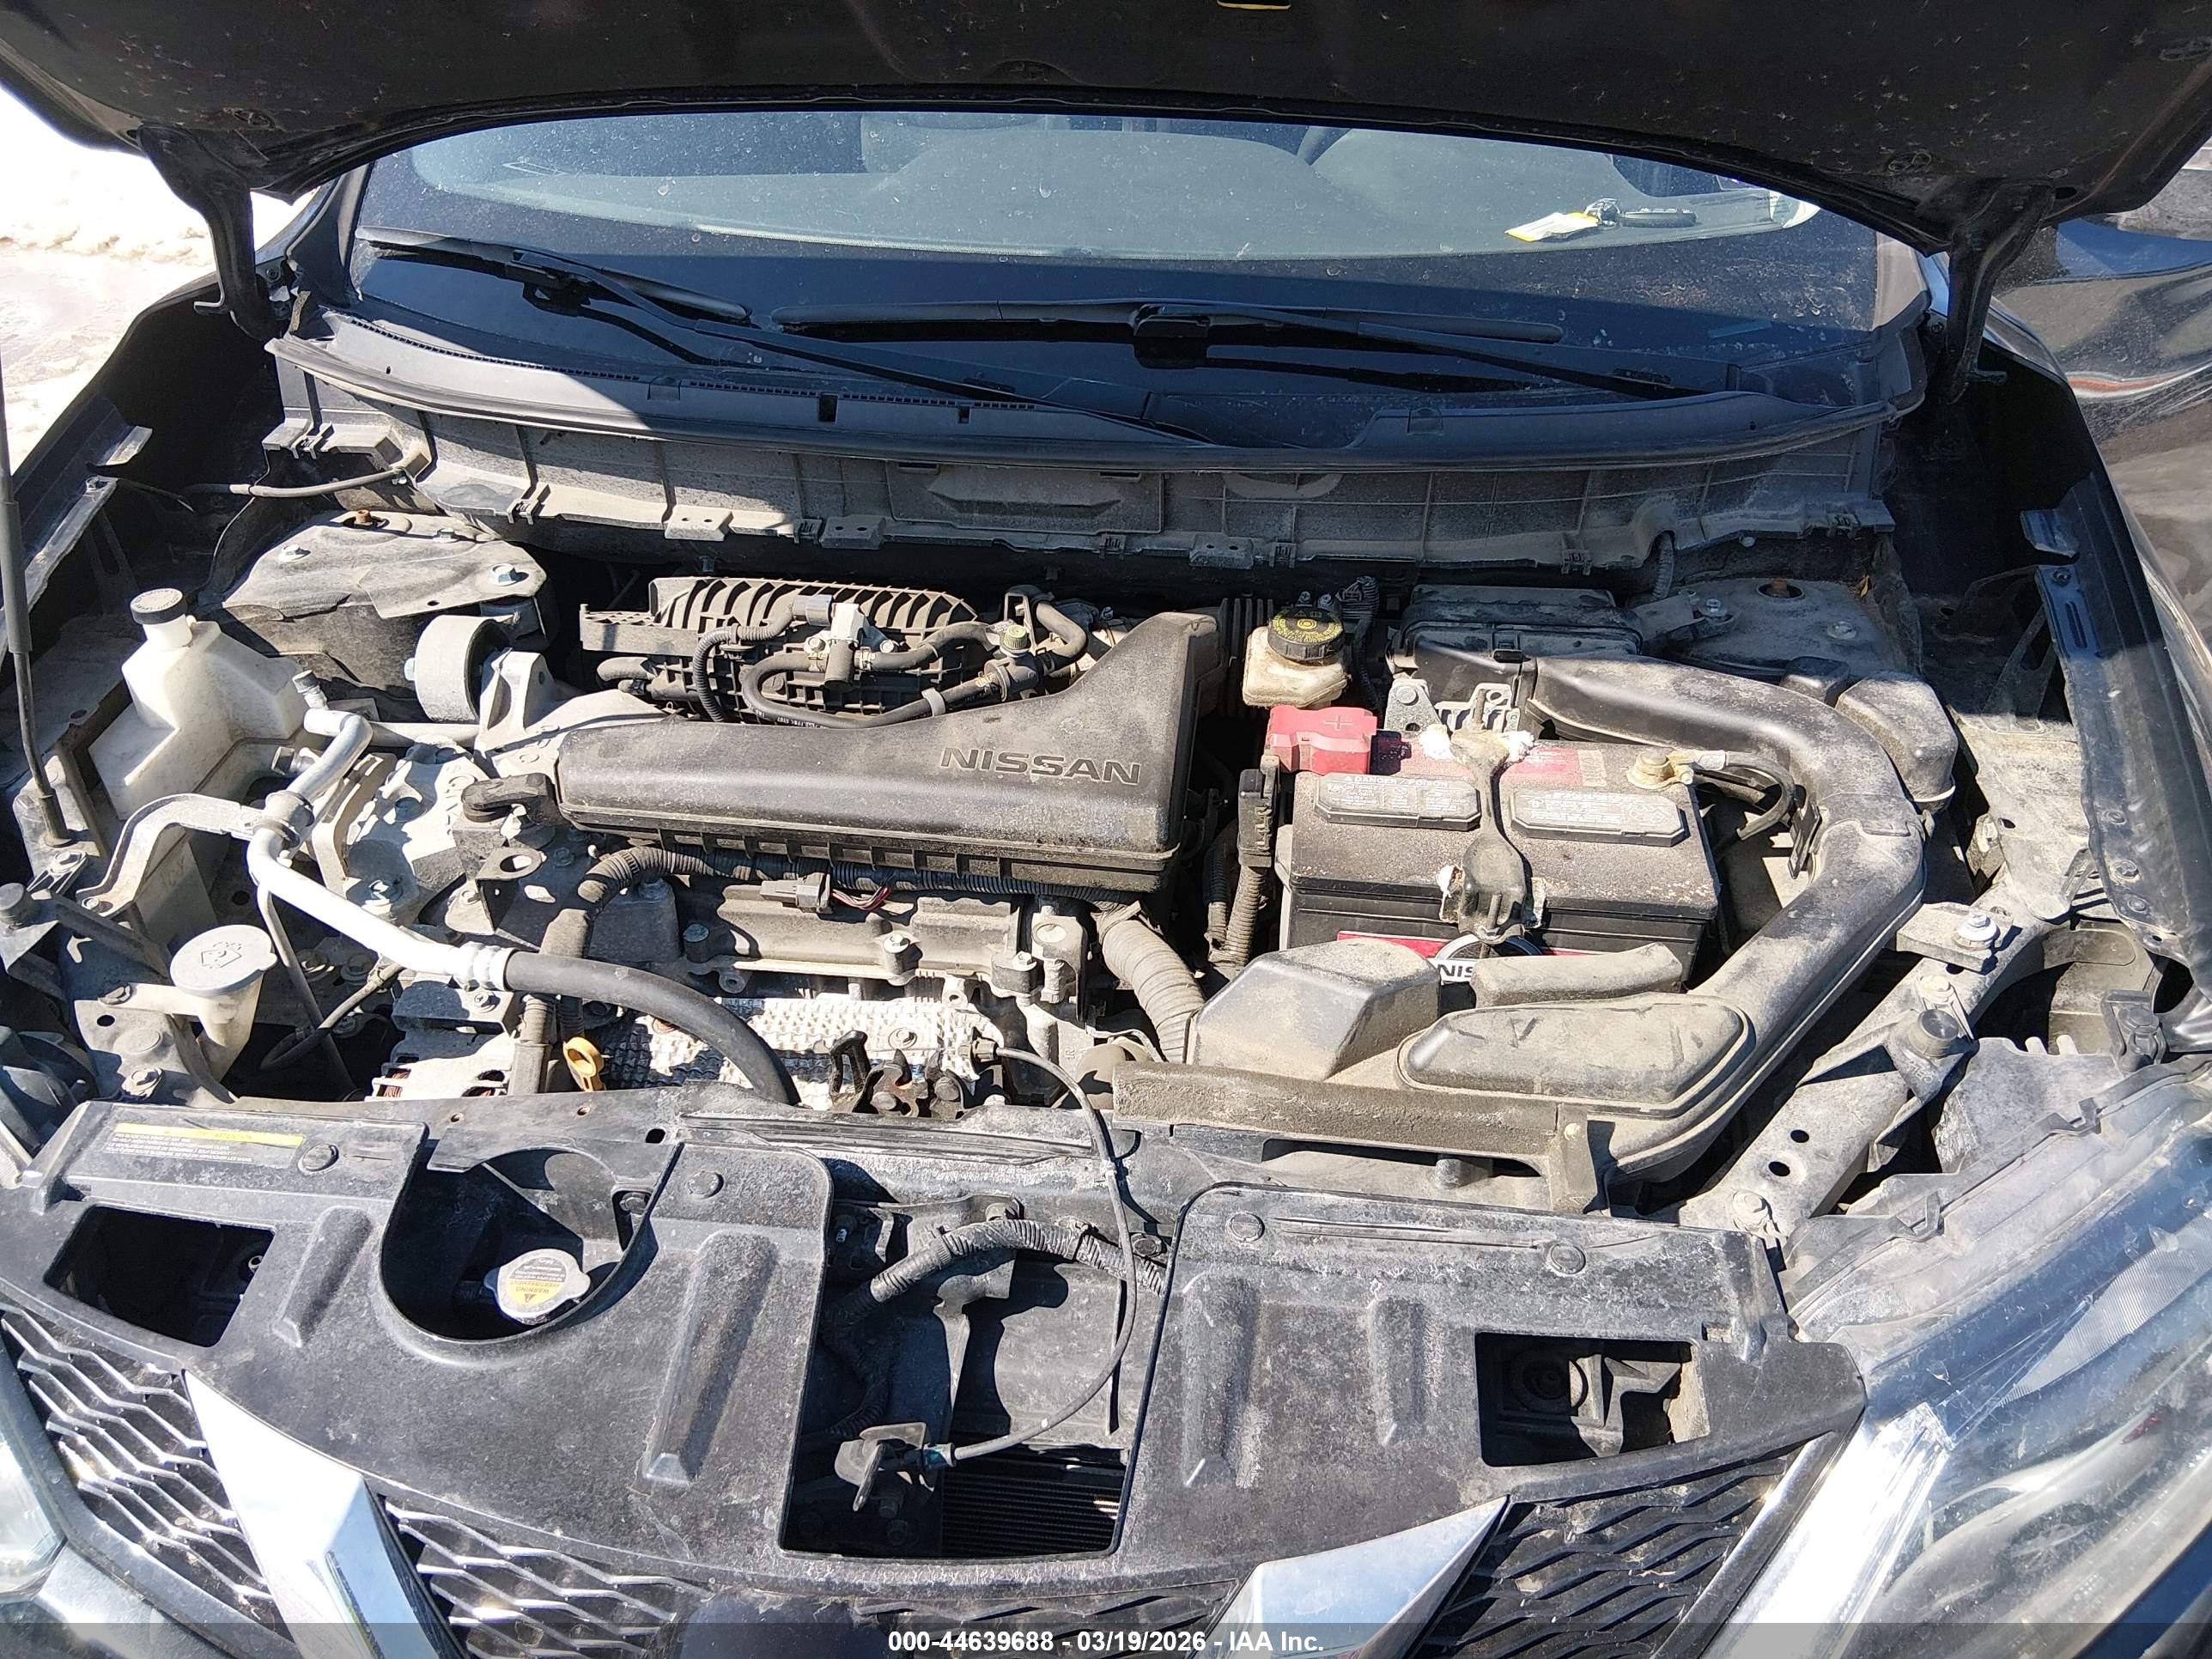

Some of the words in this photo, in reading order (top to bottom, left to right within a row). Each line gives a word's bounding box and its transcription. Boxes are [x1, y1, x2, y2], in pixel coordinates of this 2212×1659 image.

[940, 747, 1141, 786] NISSAN
[1353, 775, 1397, 785] DANGER
[1407, 778, 1449, 787] POISON
[515, 1285, 550, 1294] WARNING
